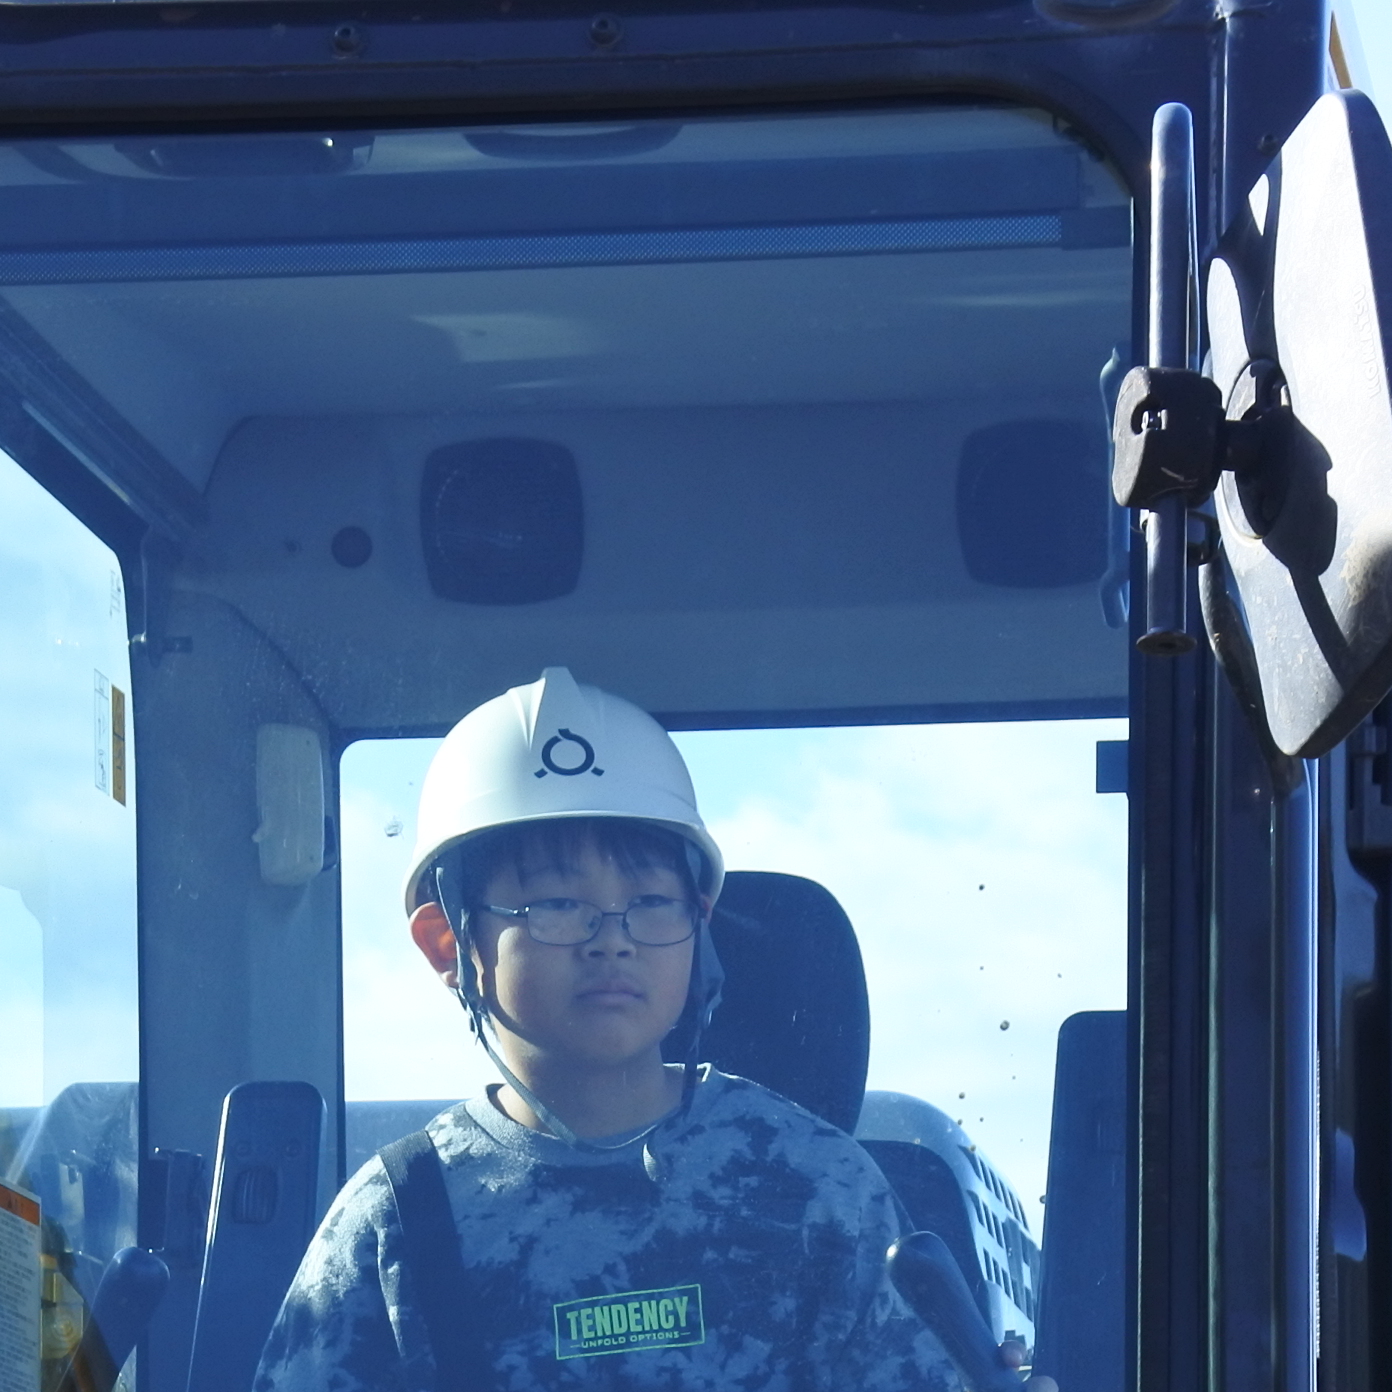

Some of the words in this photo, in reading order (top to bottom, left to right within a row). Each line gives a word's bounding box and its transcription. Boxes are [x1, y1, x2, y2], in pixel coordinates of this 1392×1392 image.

[1352, 284, 1382, 399] KOMATSU
[566, 1296, 689, 1340] TENDENCY
[581, 1336, 626, 1348] UNFOLD
[630, 1331, 680, 1342] OPTIONS
